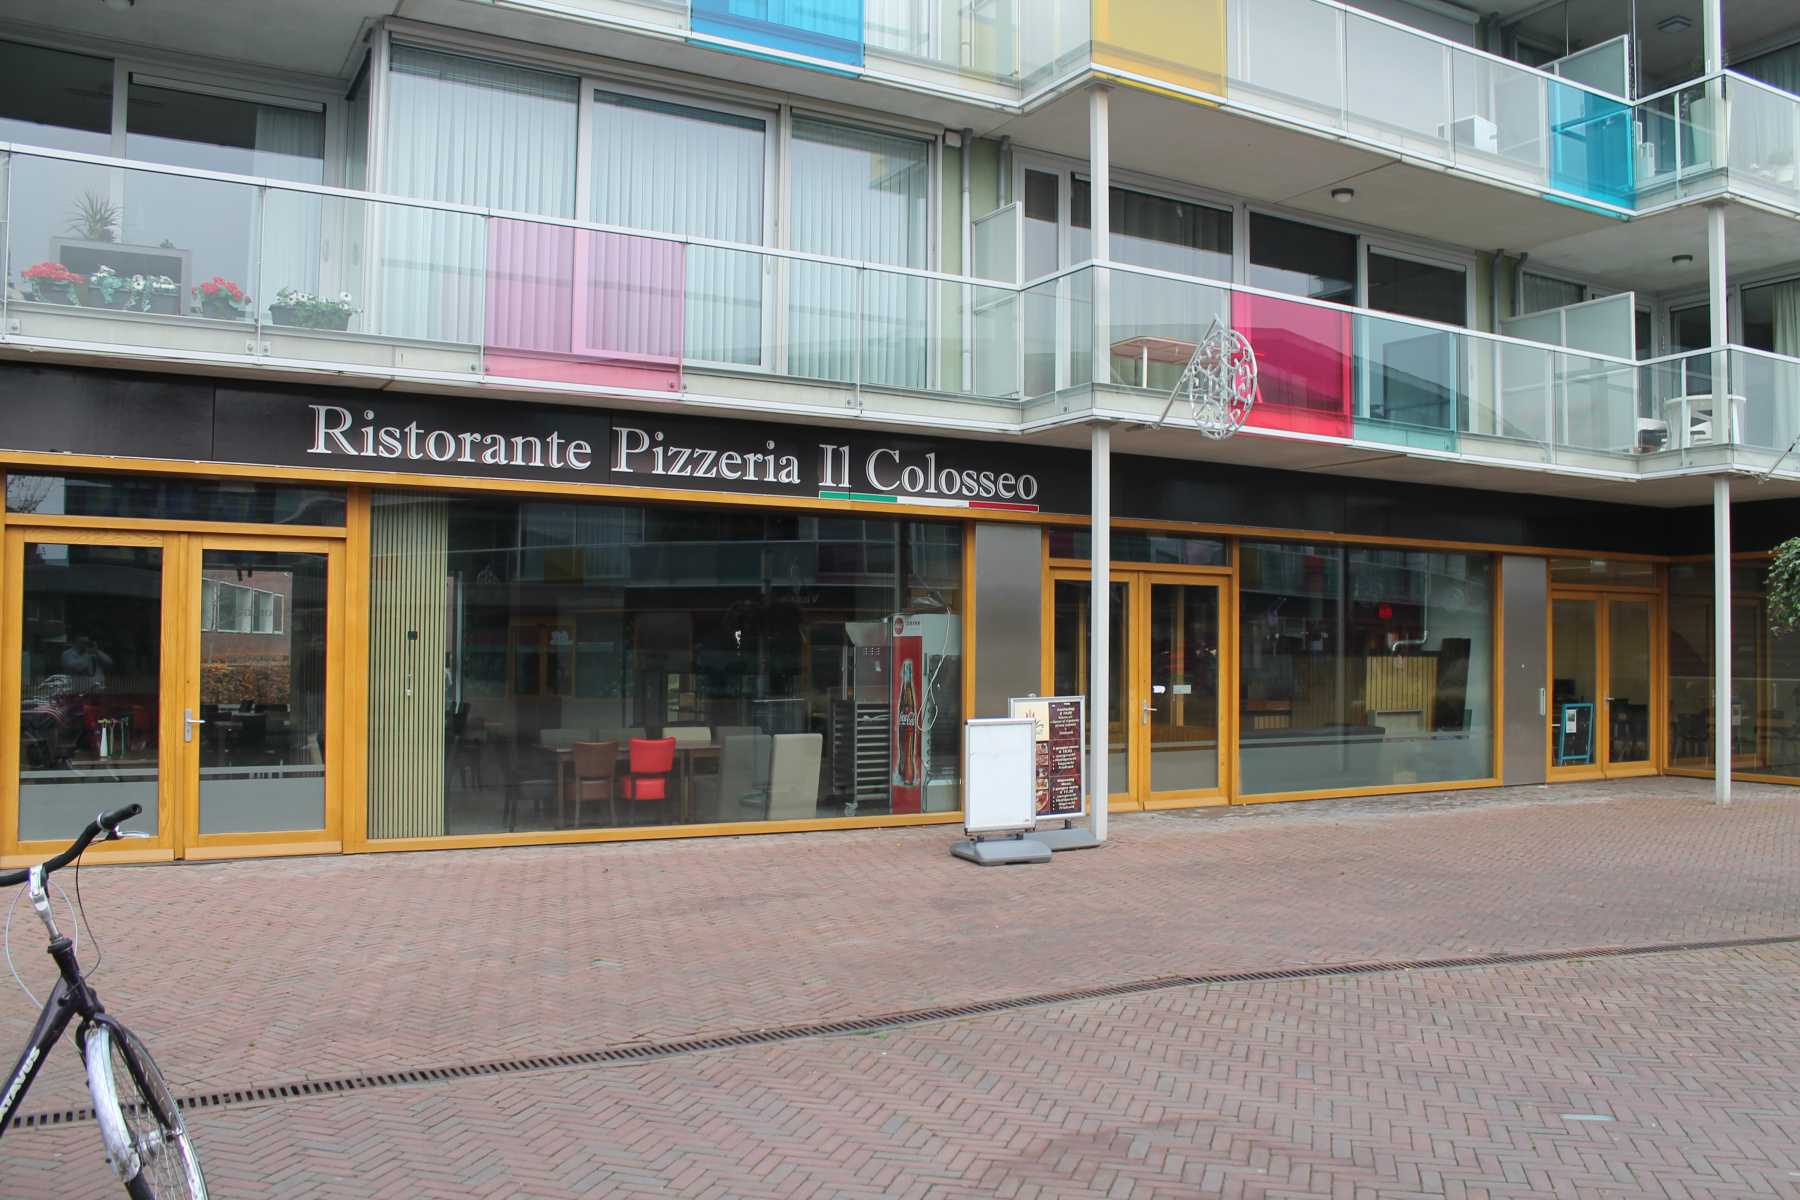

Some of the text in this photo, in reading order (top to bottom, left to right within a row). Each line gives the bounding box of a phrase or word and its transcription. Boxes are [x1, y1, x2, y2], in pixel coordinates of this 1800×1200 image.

[306, 404, 1038, 500] Ristorante Pizzeria Il Colosseo
